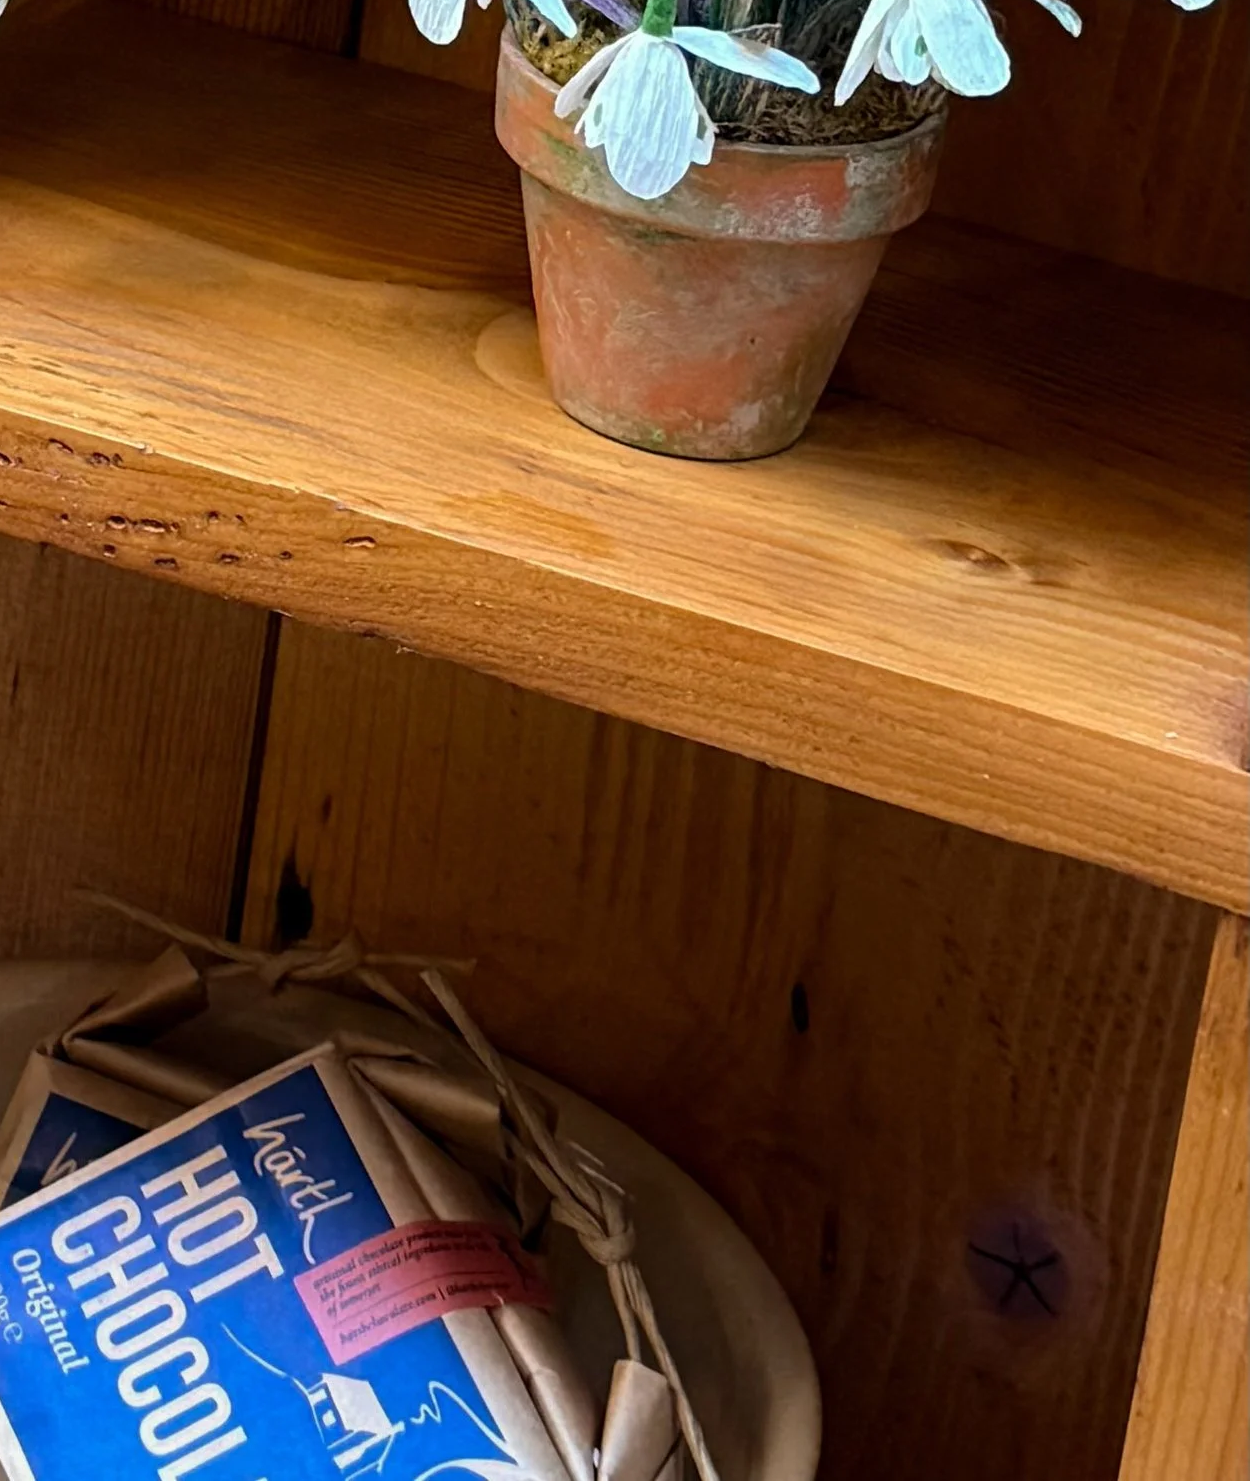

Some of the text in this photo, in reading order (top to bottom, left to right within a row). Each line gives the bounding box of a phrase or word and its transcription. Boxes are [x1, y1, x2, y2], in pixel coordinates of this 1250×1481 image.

[140, 1144, 284, 1304] HOT
[13, 1248, 90, 1375] Original
[51, 1195, 268, 1481] CHOCOL
